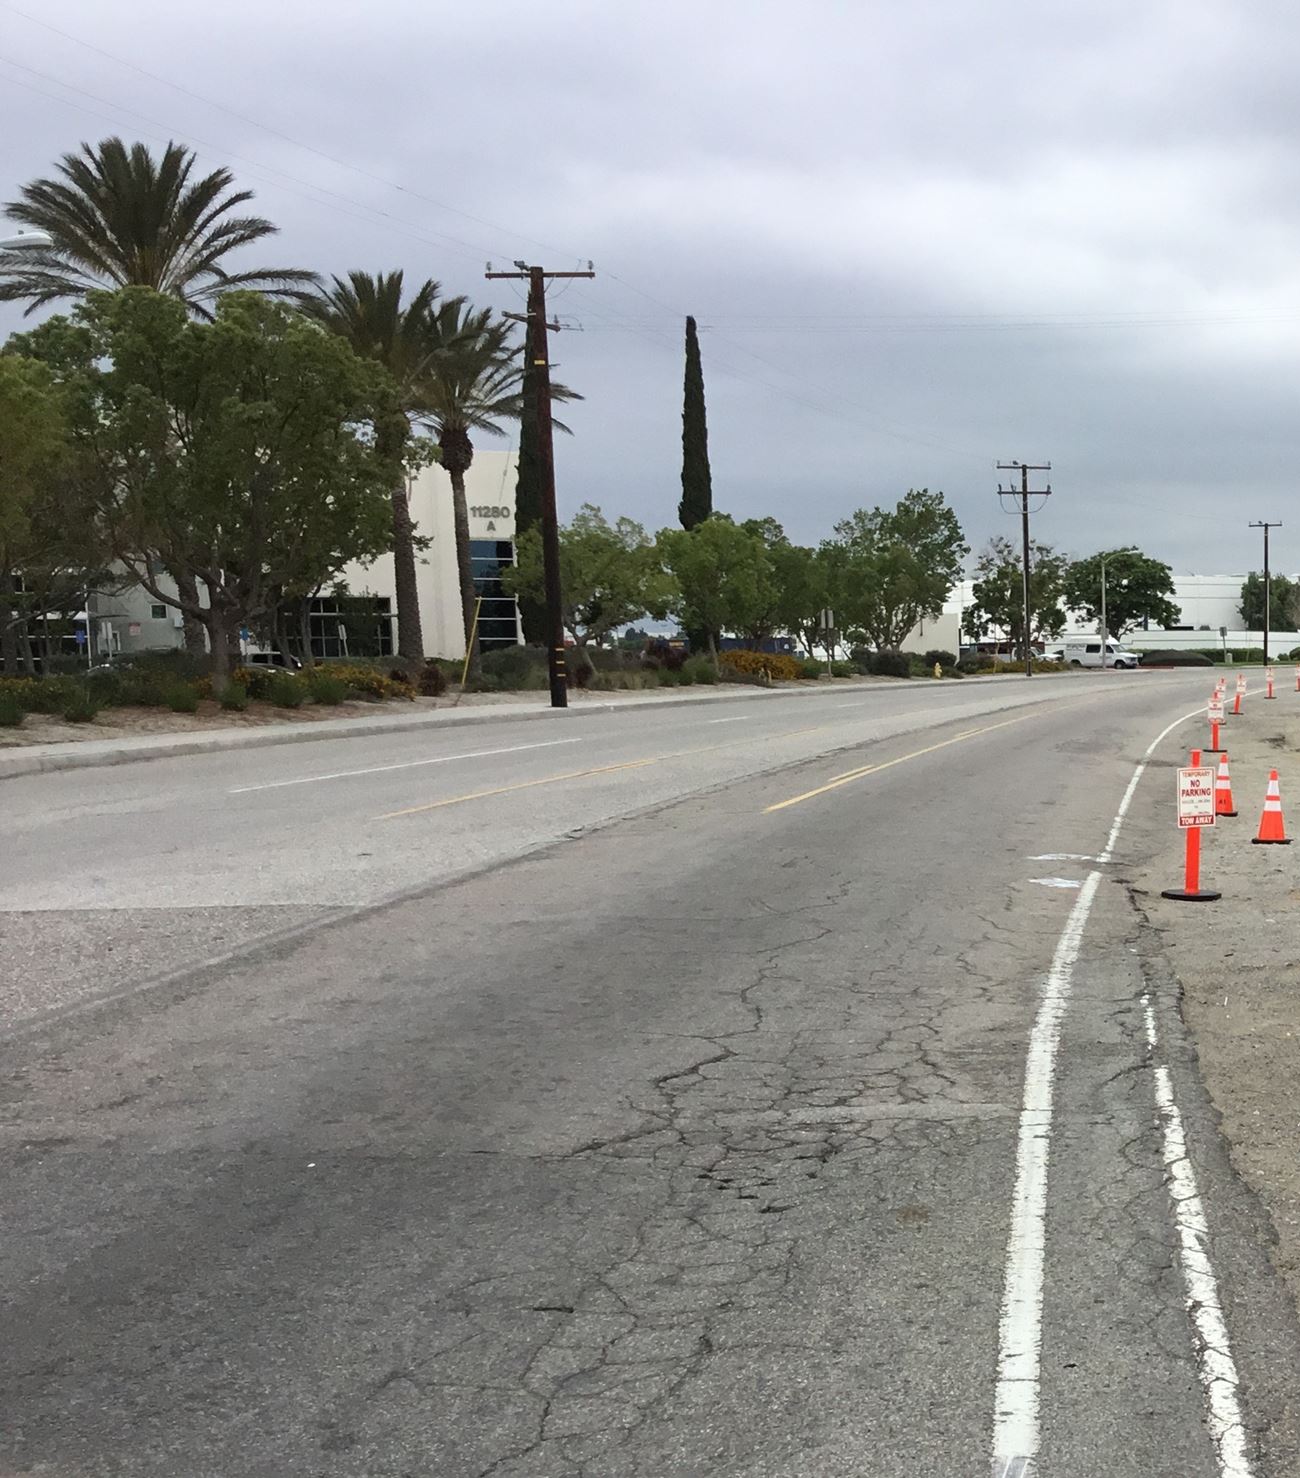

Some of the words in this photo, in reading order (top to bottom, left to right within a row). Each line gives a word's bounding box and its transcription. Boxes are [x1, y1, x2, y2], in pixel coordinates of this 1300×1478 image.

[470, 505, 510, 518] 11280
[486, 520, 496, 531] A
[1190, 779, 1200, 788] NO
[1181, 788, 1211, 797] PARKING
[1181, 817, 1194, 825] TOW
[1195, 816, 1213, 824] AWAY
